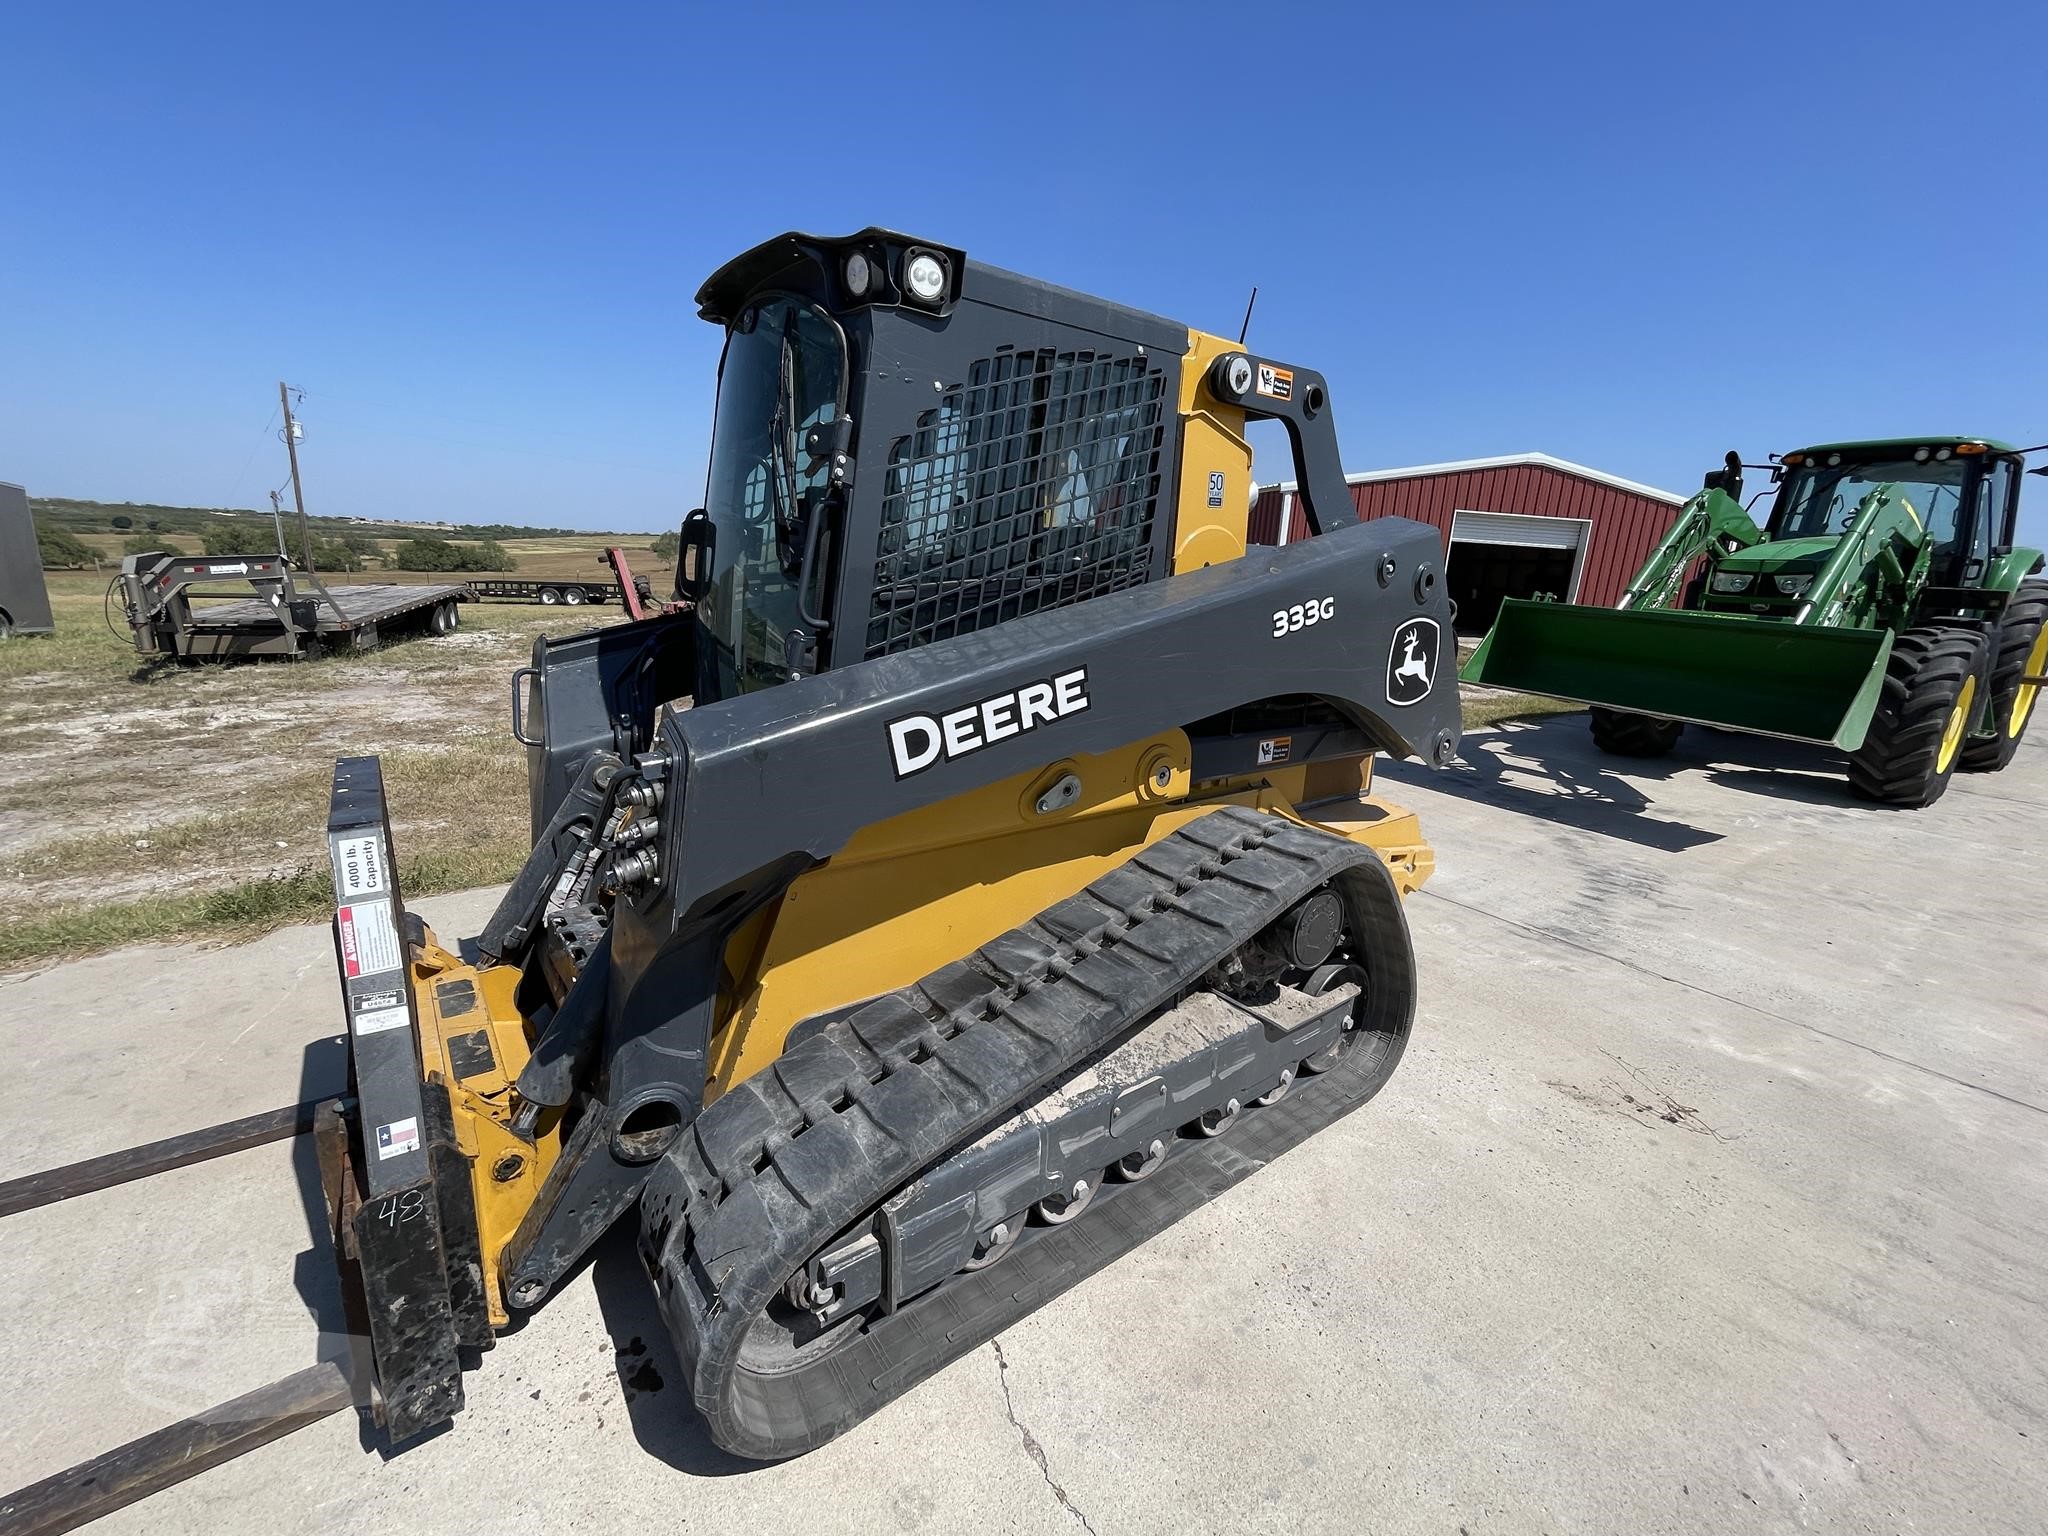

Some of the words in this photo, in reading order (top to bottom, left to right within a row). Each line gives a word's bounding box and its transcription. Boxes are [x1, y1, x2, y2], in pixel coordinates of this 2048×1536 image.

[1209, 473, 1224, 491] 50
[1272, 596, 1335, 638] 333G
[888, 668, 1089, 777] DEERE
[346, 844, 358, 859] lb.
[362, 840, 378, 888] Capacity
[347, 861, 361, 888] 4000
[342, 920, 357, 954] DANGER
[379, 1190, 424, 1227] 48
